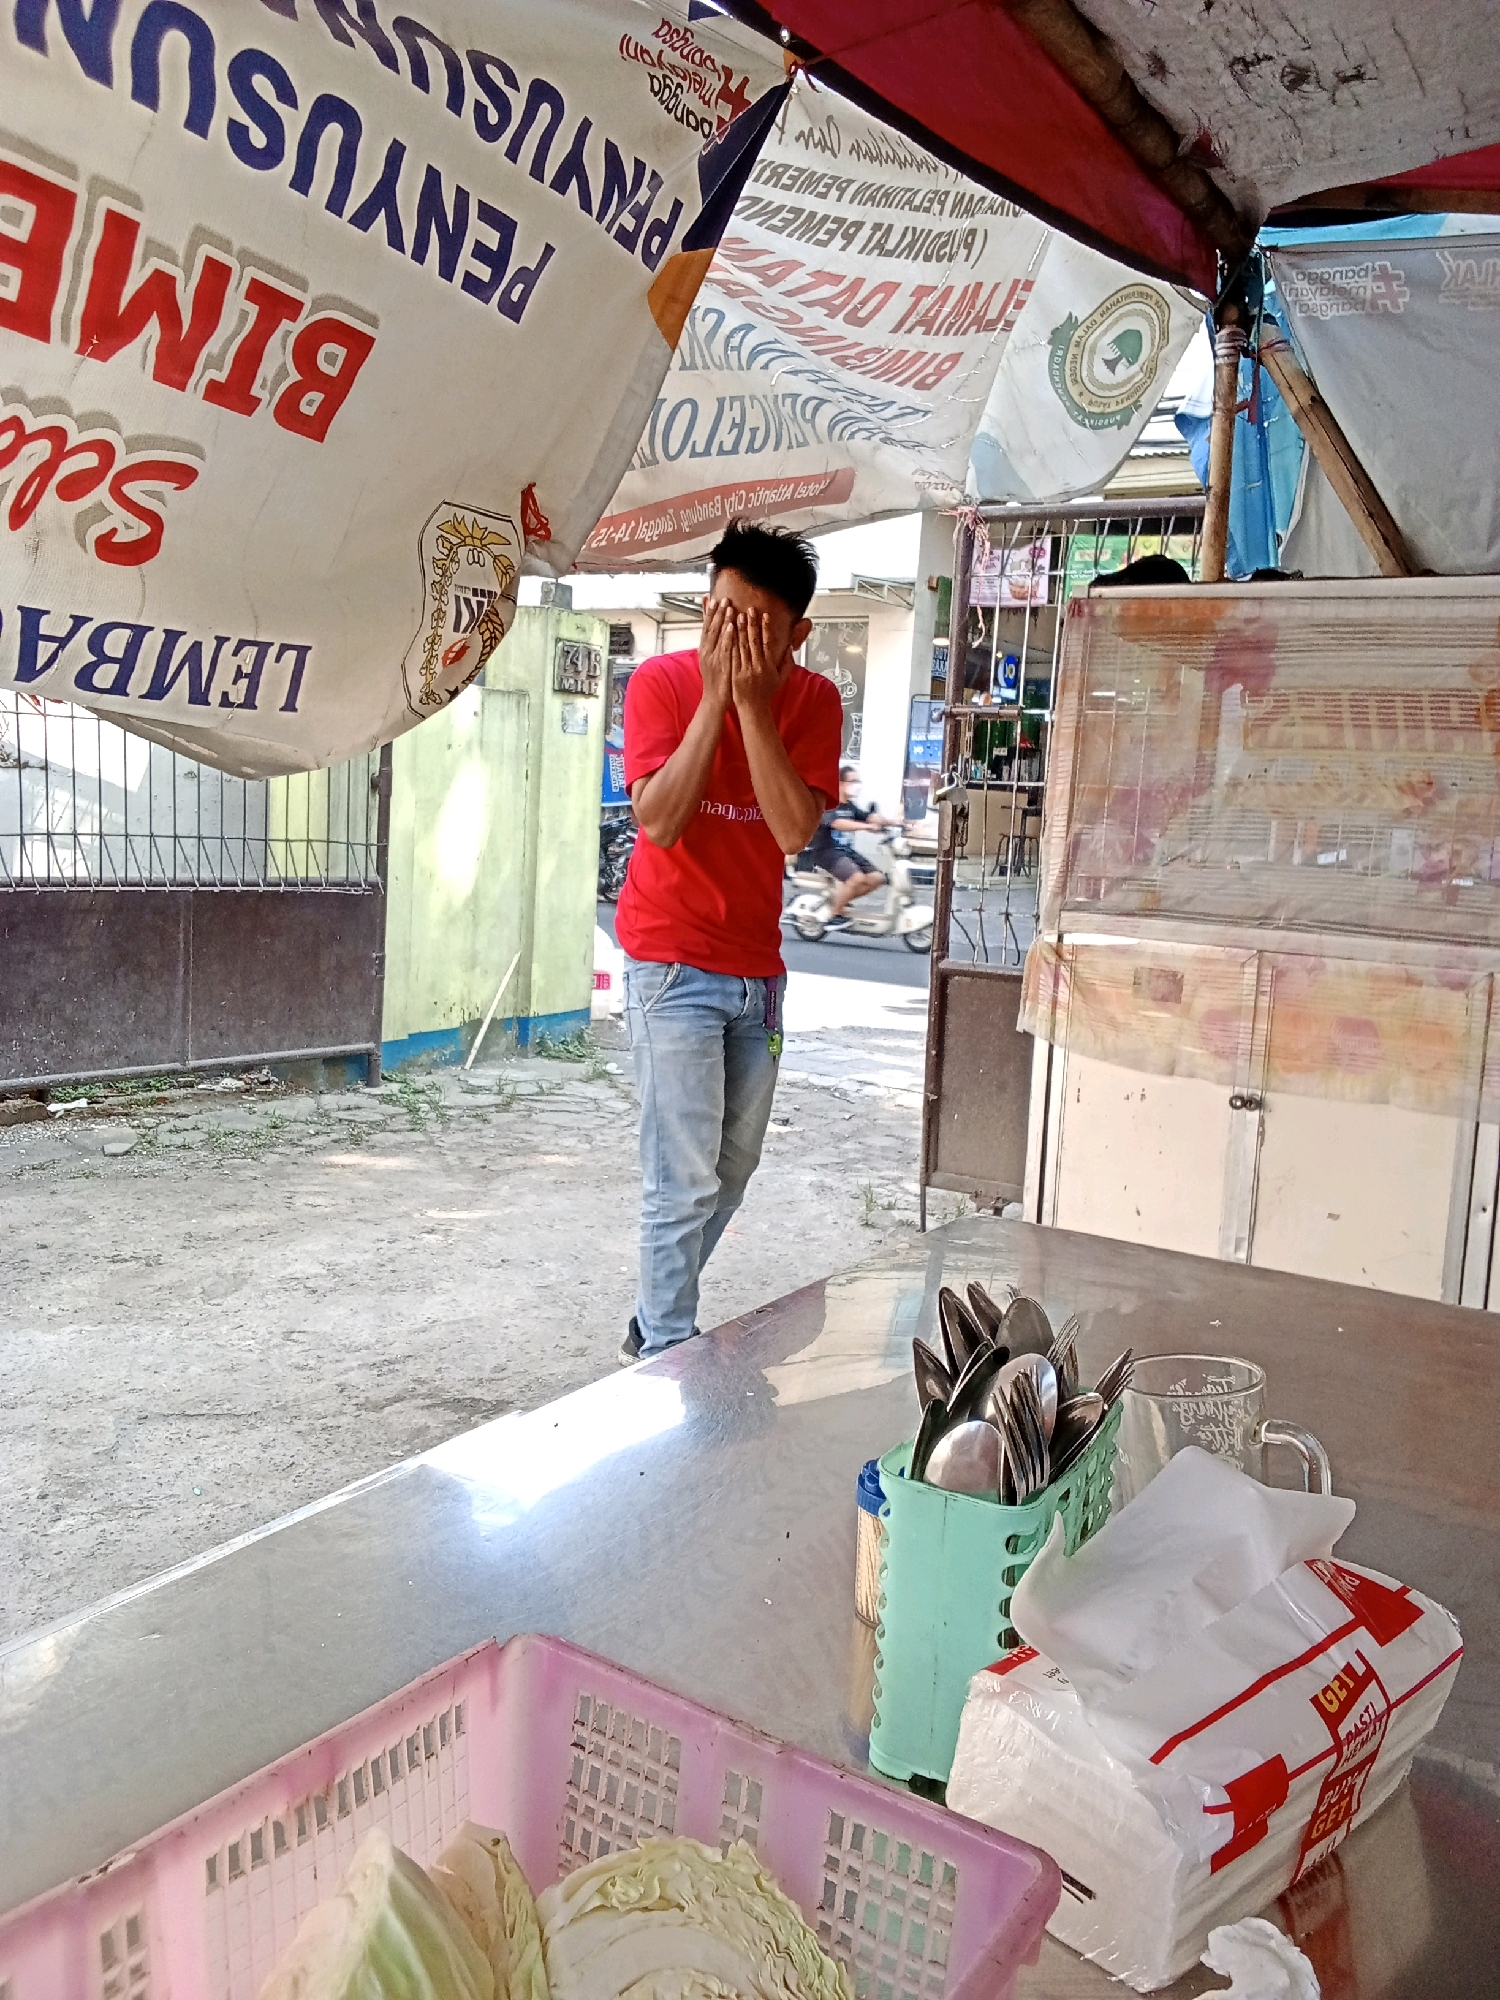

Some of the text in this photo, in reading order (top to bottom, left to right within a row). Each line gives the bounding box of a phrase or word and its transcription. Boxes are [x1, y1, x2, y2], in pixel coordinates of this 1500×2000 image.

[619, 33, 716, 109] melayani
[651, 17, 721, 82] bangsa
[258, 0, 684, 272] PENYUSUN
[0, 604, 312, 713] LEMBA
